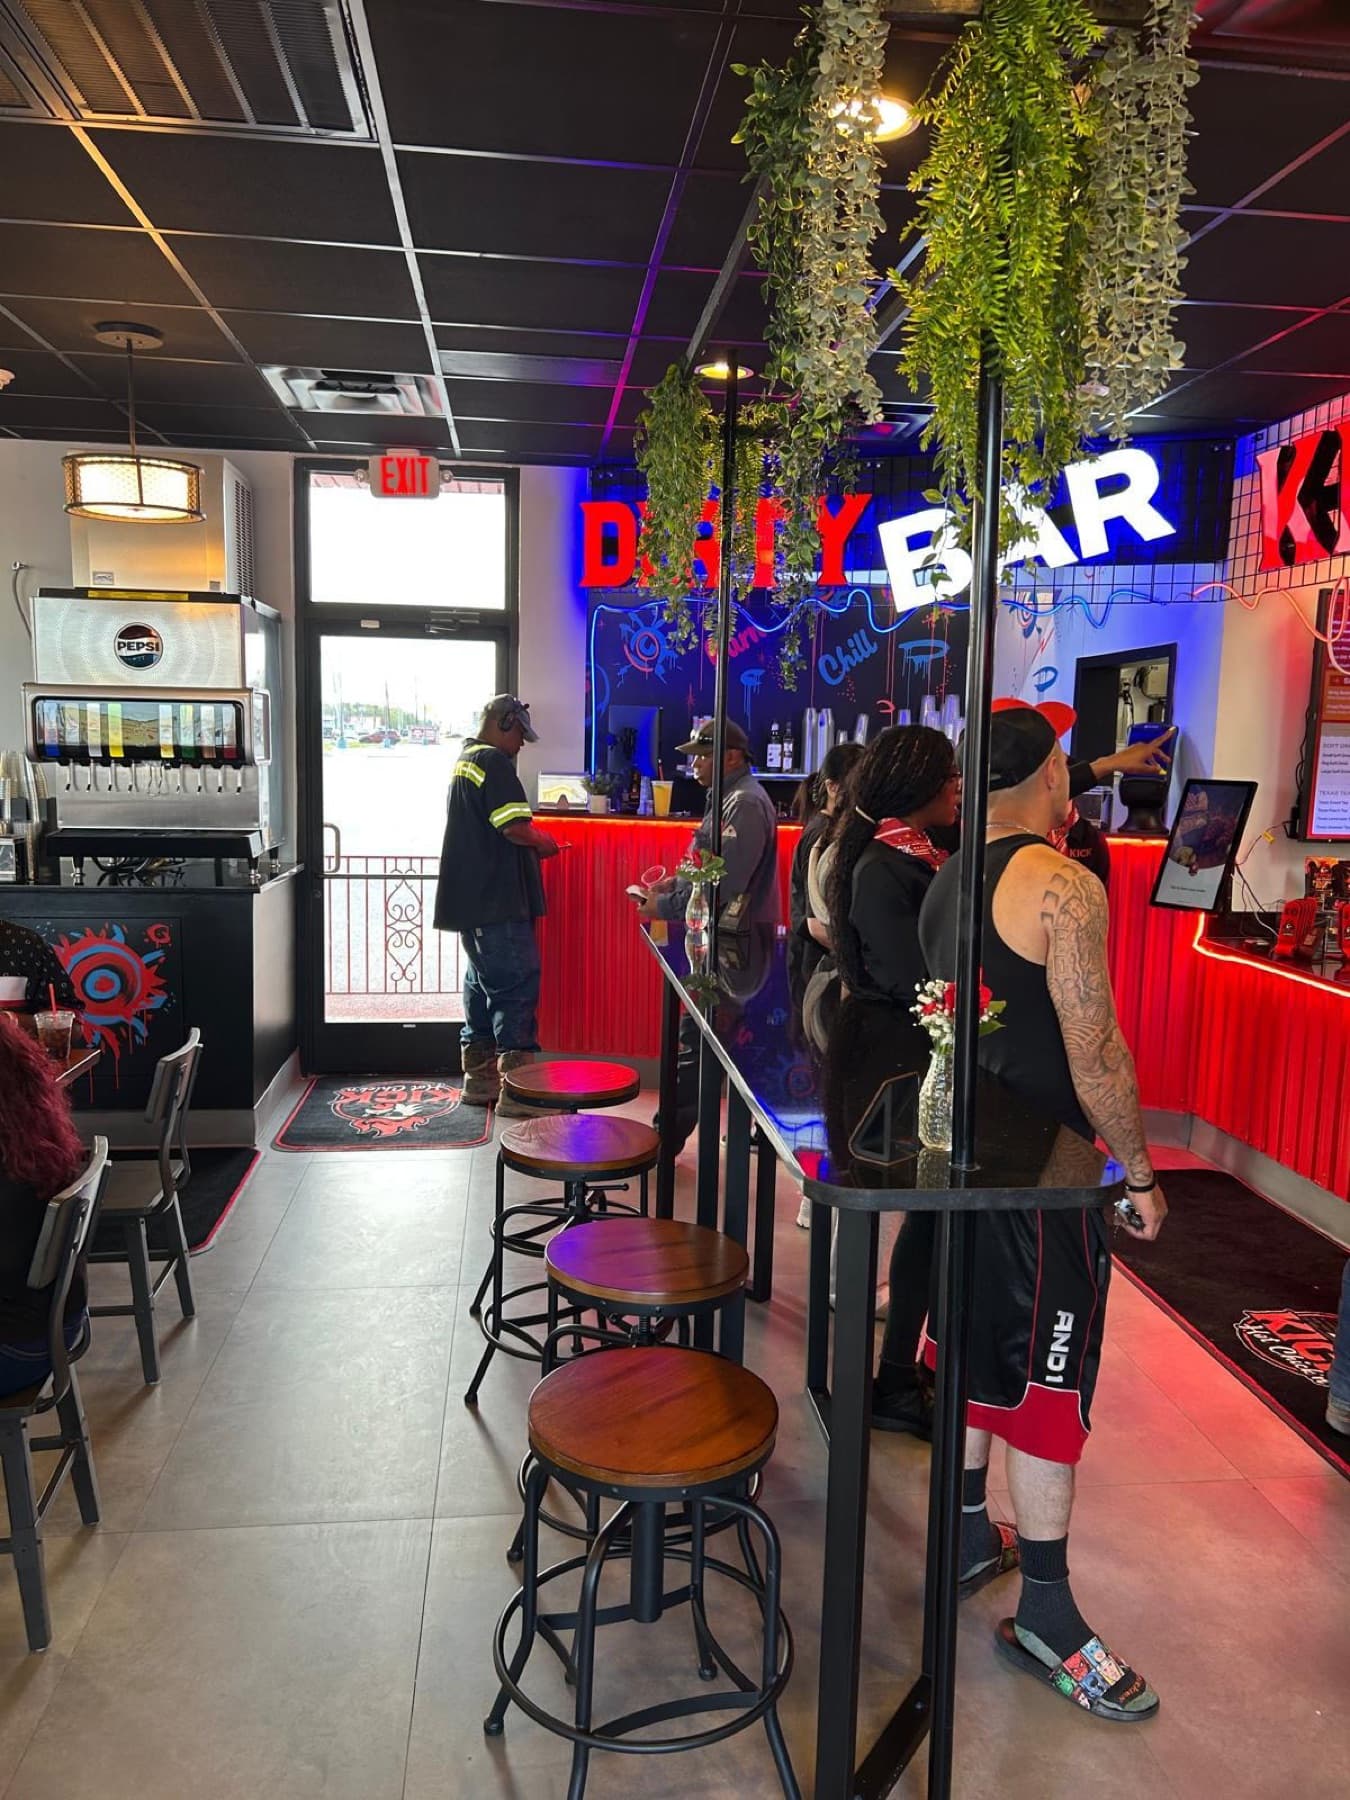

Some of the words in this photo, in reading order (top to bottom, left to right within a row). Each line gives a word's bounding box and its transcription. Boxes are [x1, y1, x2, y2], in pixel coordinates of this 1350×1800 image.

[380, 456, 431, 495] EXIT
[117, 640, 160, 652] PEPSI
[818, 628, 878, 686] Chill
[1069, 847, 1093, 858] KICK
[336, 1088, 462, 1104] KICK
[1238, 1323, 1281, 1343] Hot
[1249, 1311, 1335, 1371] KIC
